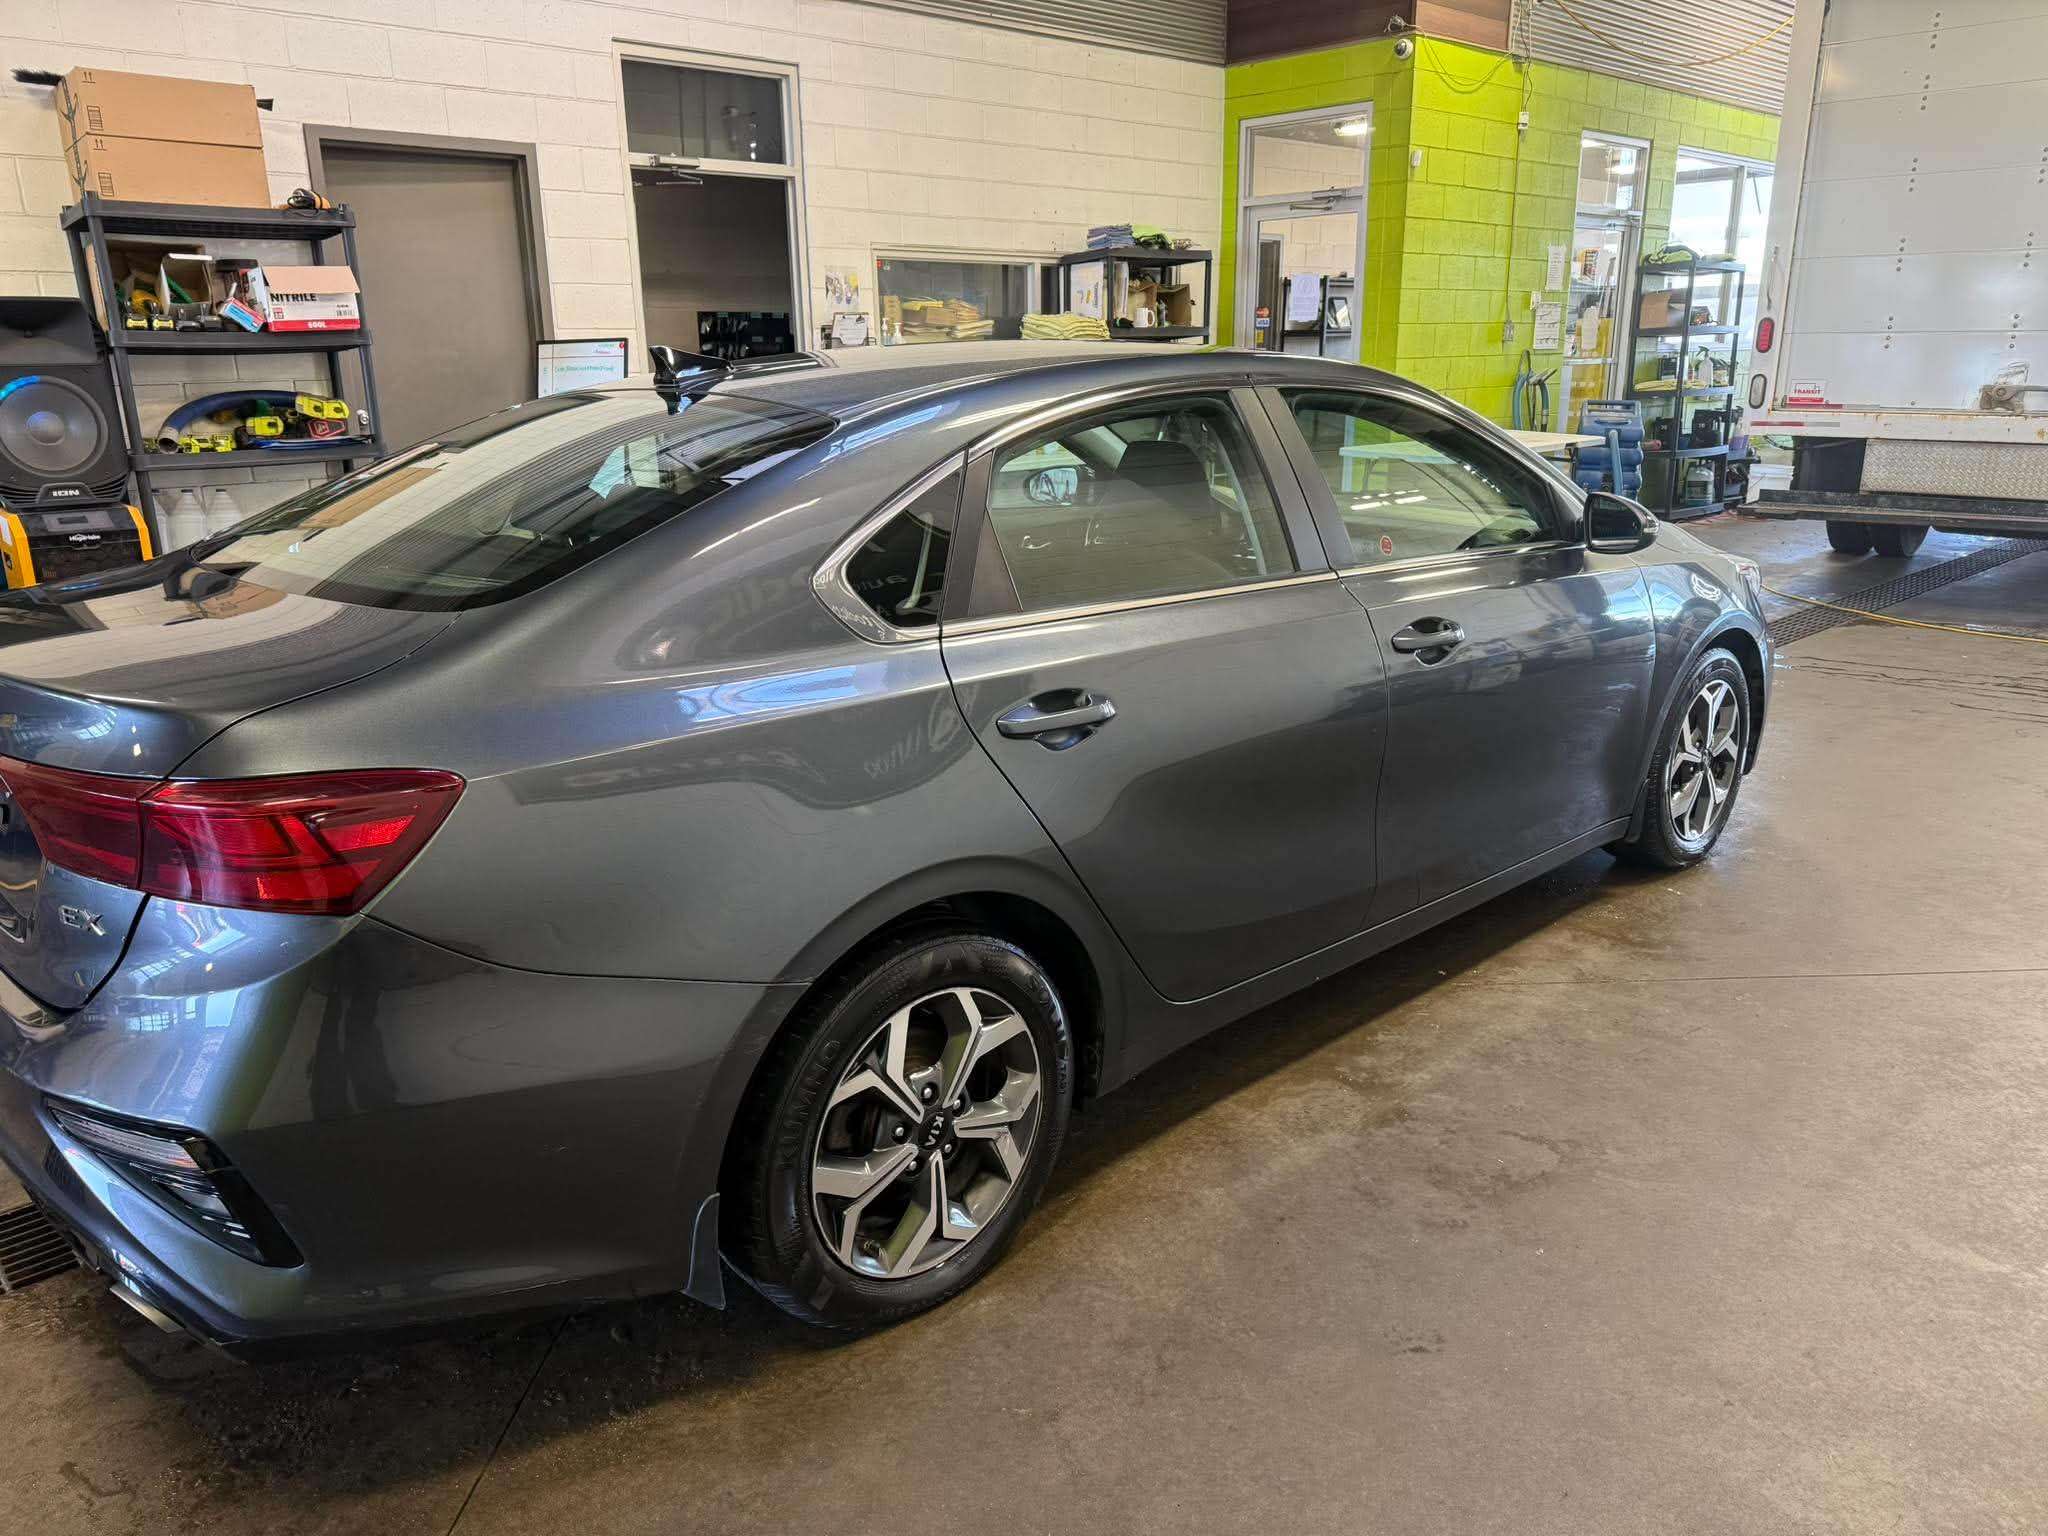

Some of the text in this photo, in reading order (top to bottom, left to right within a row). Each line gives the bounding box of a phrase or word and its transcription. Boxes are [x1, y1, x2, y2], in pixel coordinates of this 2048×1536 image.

[270, 293, 317, 302] NITRILE
[59, 905, 106, 936] EX
[924, 1115, 945, 1147] KIA
